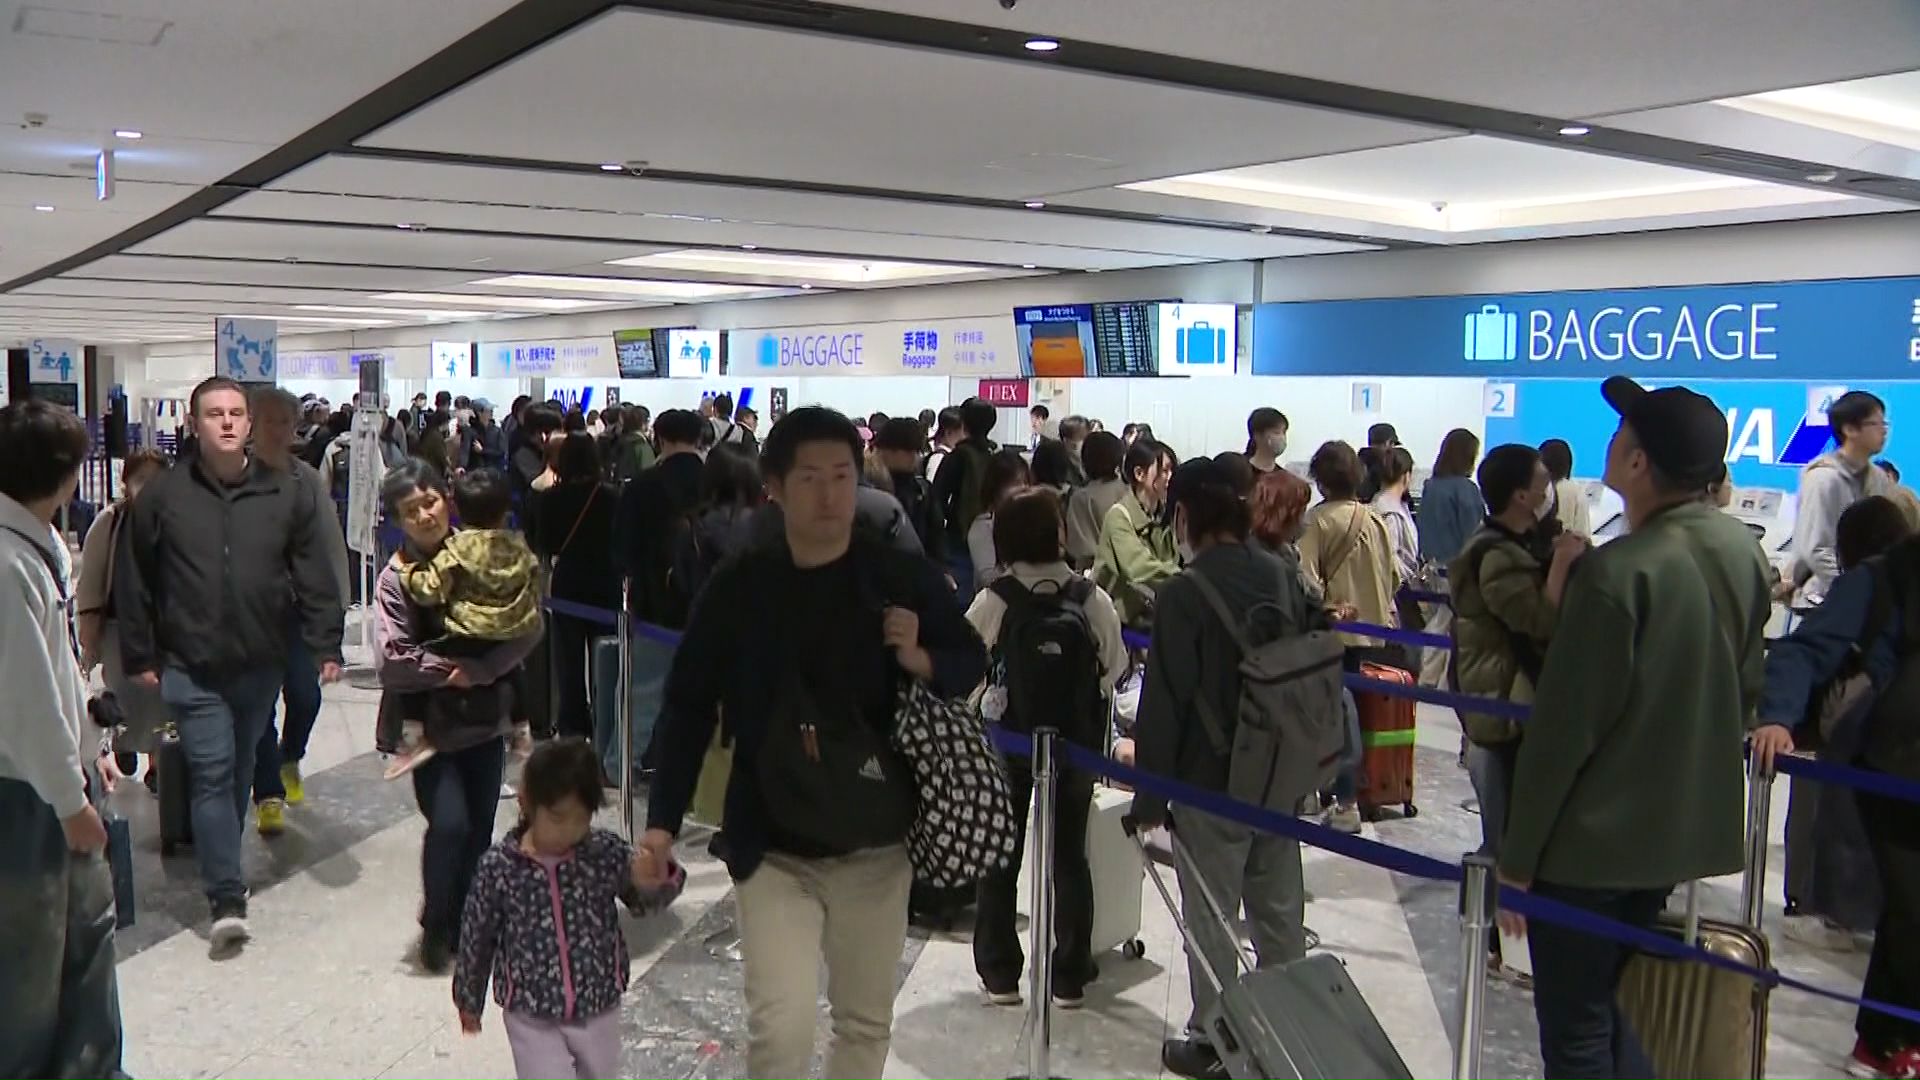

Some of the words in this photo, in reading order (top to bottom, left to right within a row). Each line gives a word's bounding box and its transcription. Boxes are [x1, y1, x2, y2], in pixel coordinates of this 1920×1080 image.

[1171, 305, 1181, 321] 4
[222, 320, 236, 341] 4
[903, 330, 938, 351] 手荷物
[1529, 303, 1779, 361] BAGGAGE
[33, 340, 42, 354] 5
[781, 334, 864, 366] BAGGAGE
[1362, 388, 1370, 409] 1
[1491, 390, 1505, 412] 2
